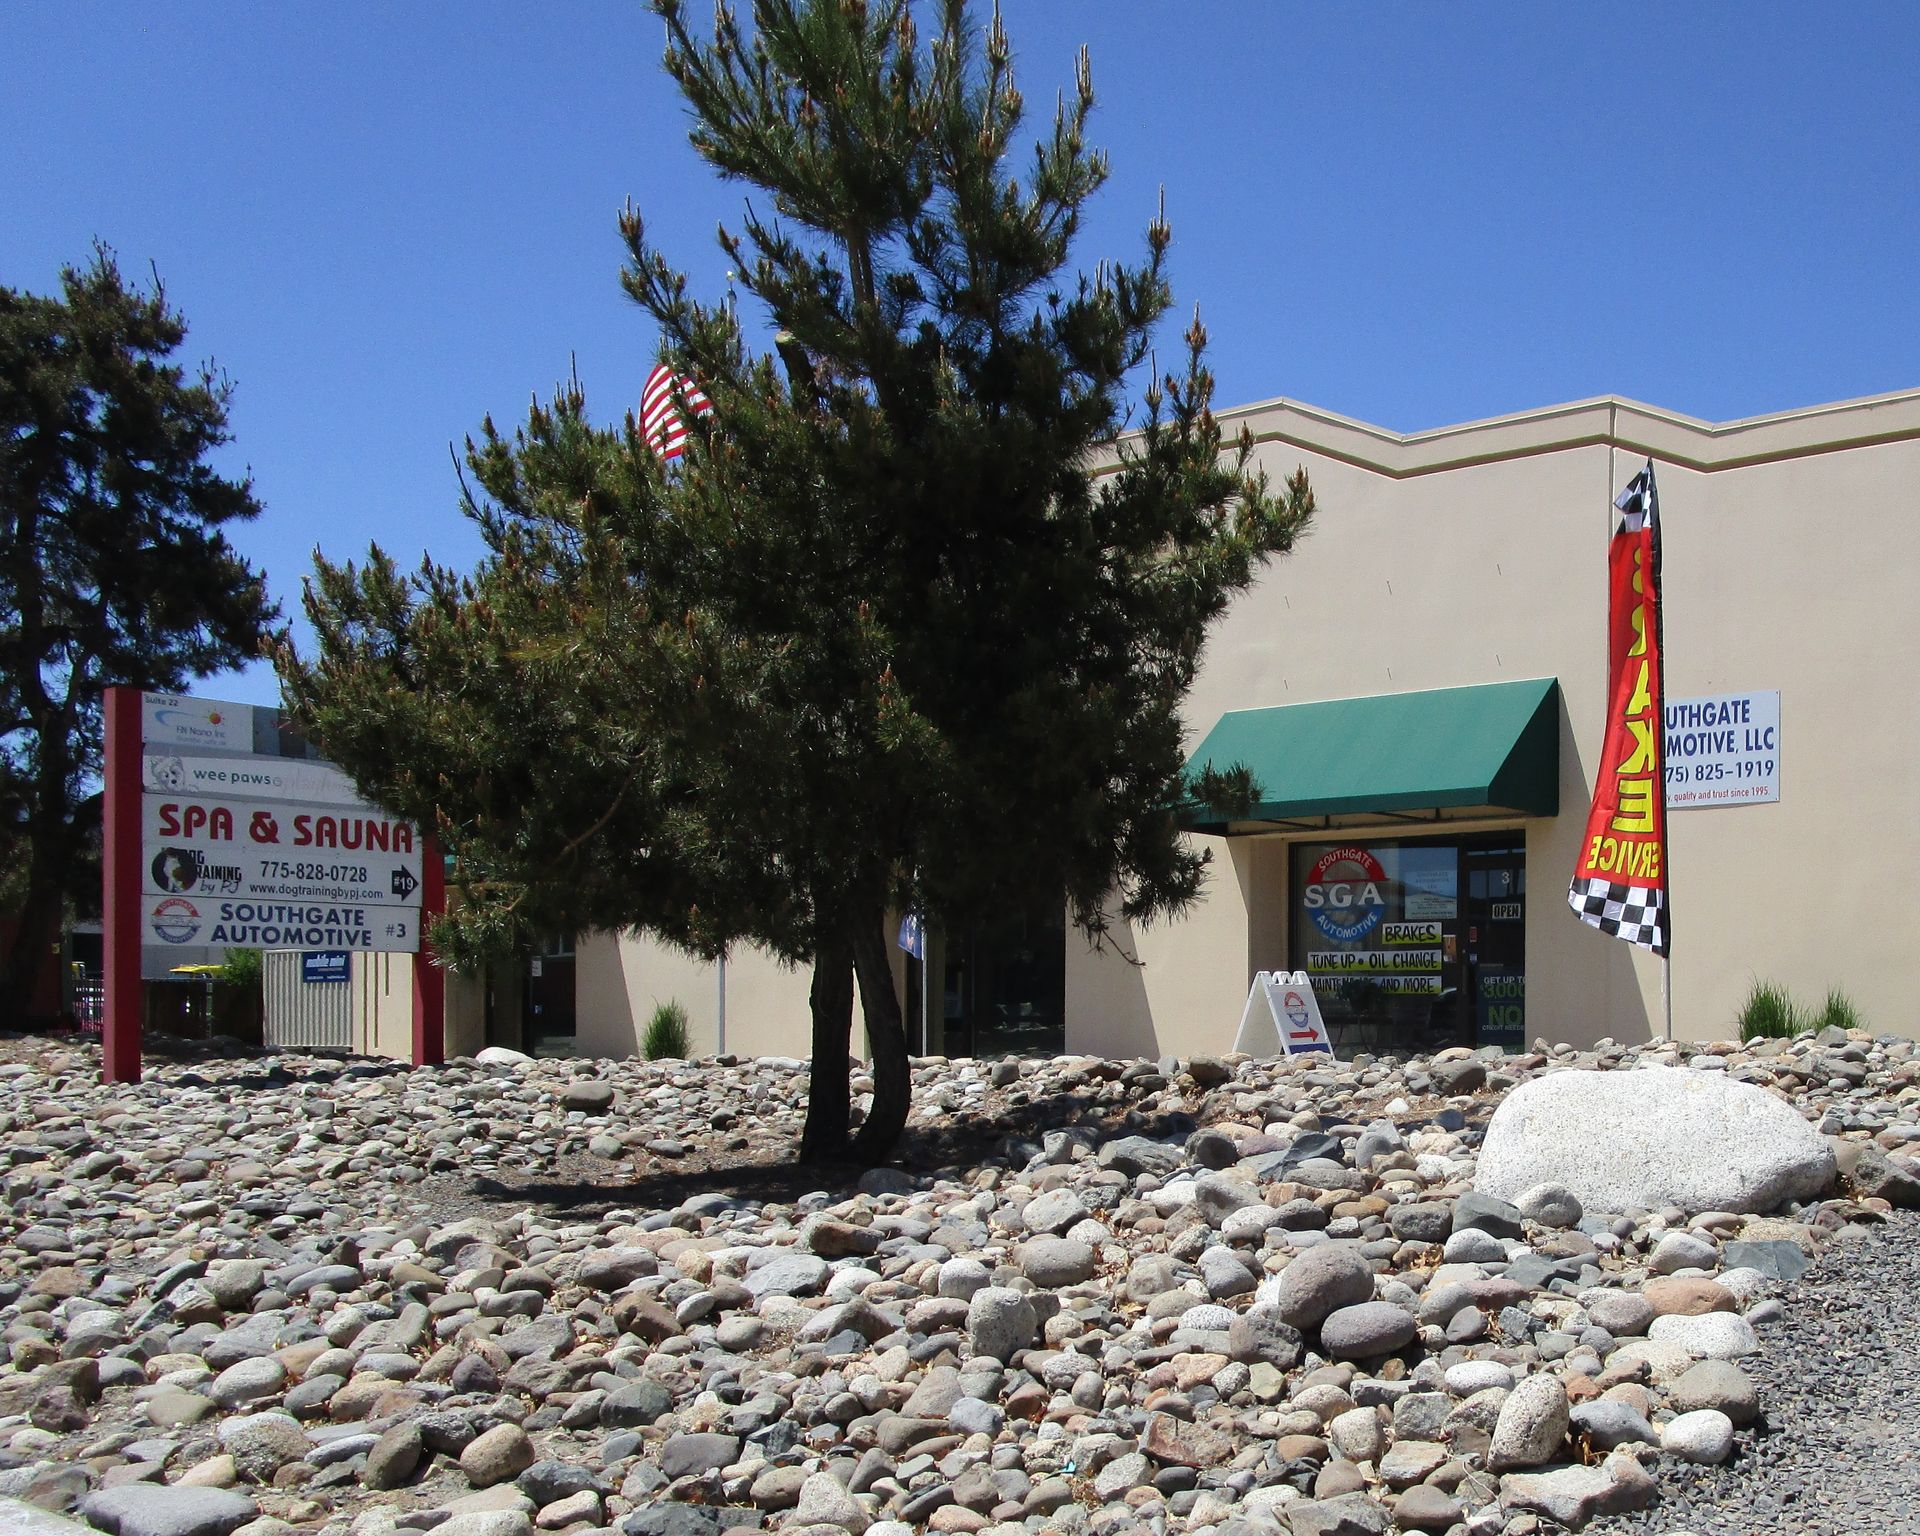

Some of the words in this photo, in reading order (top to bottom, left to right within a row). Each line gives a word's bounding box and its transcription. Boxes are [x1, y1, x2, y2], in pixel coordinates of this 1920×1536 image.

[145, 696, 167, 706] Suite
[169, 699, 178, 707] 22
[190, 726, 213, 737] Nano
[1745, 726, 1775, 752] LLC
[193, 769, 227, 781] wee
[231, 772, 271, 785] paws
[1695, 759, 1775, 781] 825-1919
[1674, 790, 1697, 803] quality
[1698, 789, 1711, 800] and
[1713, 788, 1729, 799] trust
[1730, 786, 1750, 798] since
[159, 803, 233, 841] SPA
[249, 811, 280, 844] &
[293, 815, 413, 854] SAUNA
[1318, 848, 1374, 872] SOUTHGATE
[260, 860, 367, 883] 775-828-0728
[1502, 871, 1510, 884] 3
[200, 880, 215, 895] by
[221, 880, 239, 894] PJ
[249, 883, 384, 900] www.dogtrainingbypj.com
[393, 875, 414, 891] #19
[1303, 882, 1385, 908] SGA
[220, 902, 365, 927] SOUTHGATE
[1494, 903, 1520, 919] OPEN
[385, 923, 406, 939] #3
[1316, 911, 1379, 938] AUTOMOTIVE
[211, 924, 372, 947] AUTOMOTIVE
[1384, 924, 1438, 944] BRAKES
[1310, 953, 1338, 970] TUNE
[1341, 953, 1356, 969] UP
[1368, 952, 1390, 969] OIL
[1393, 951, 1438, 969] CHANGE
[1378, 977, 1400, 992] AND
[1403, 976, 1435, 993] MORE
[1484, 976, 1500, 985] GET
[1503, 975, 1515, 985] UP
[1488, 1005, 1522, 1026] NO
